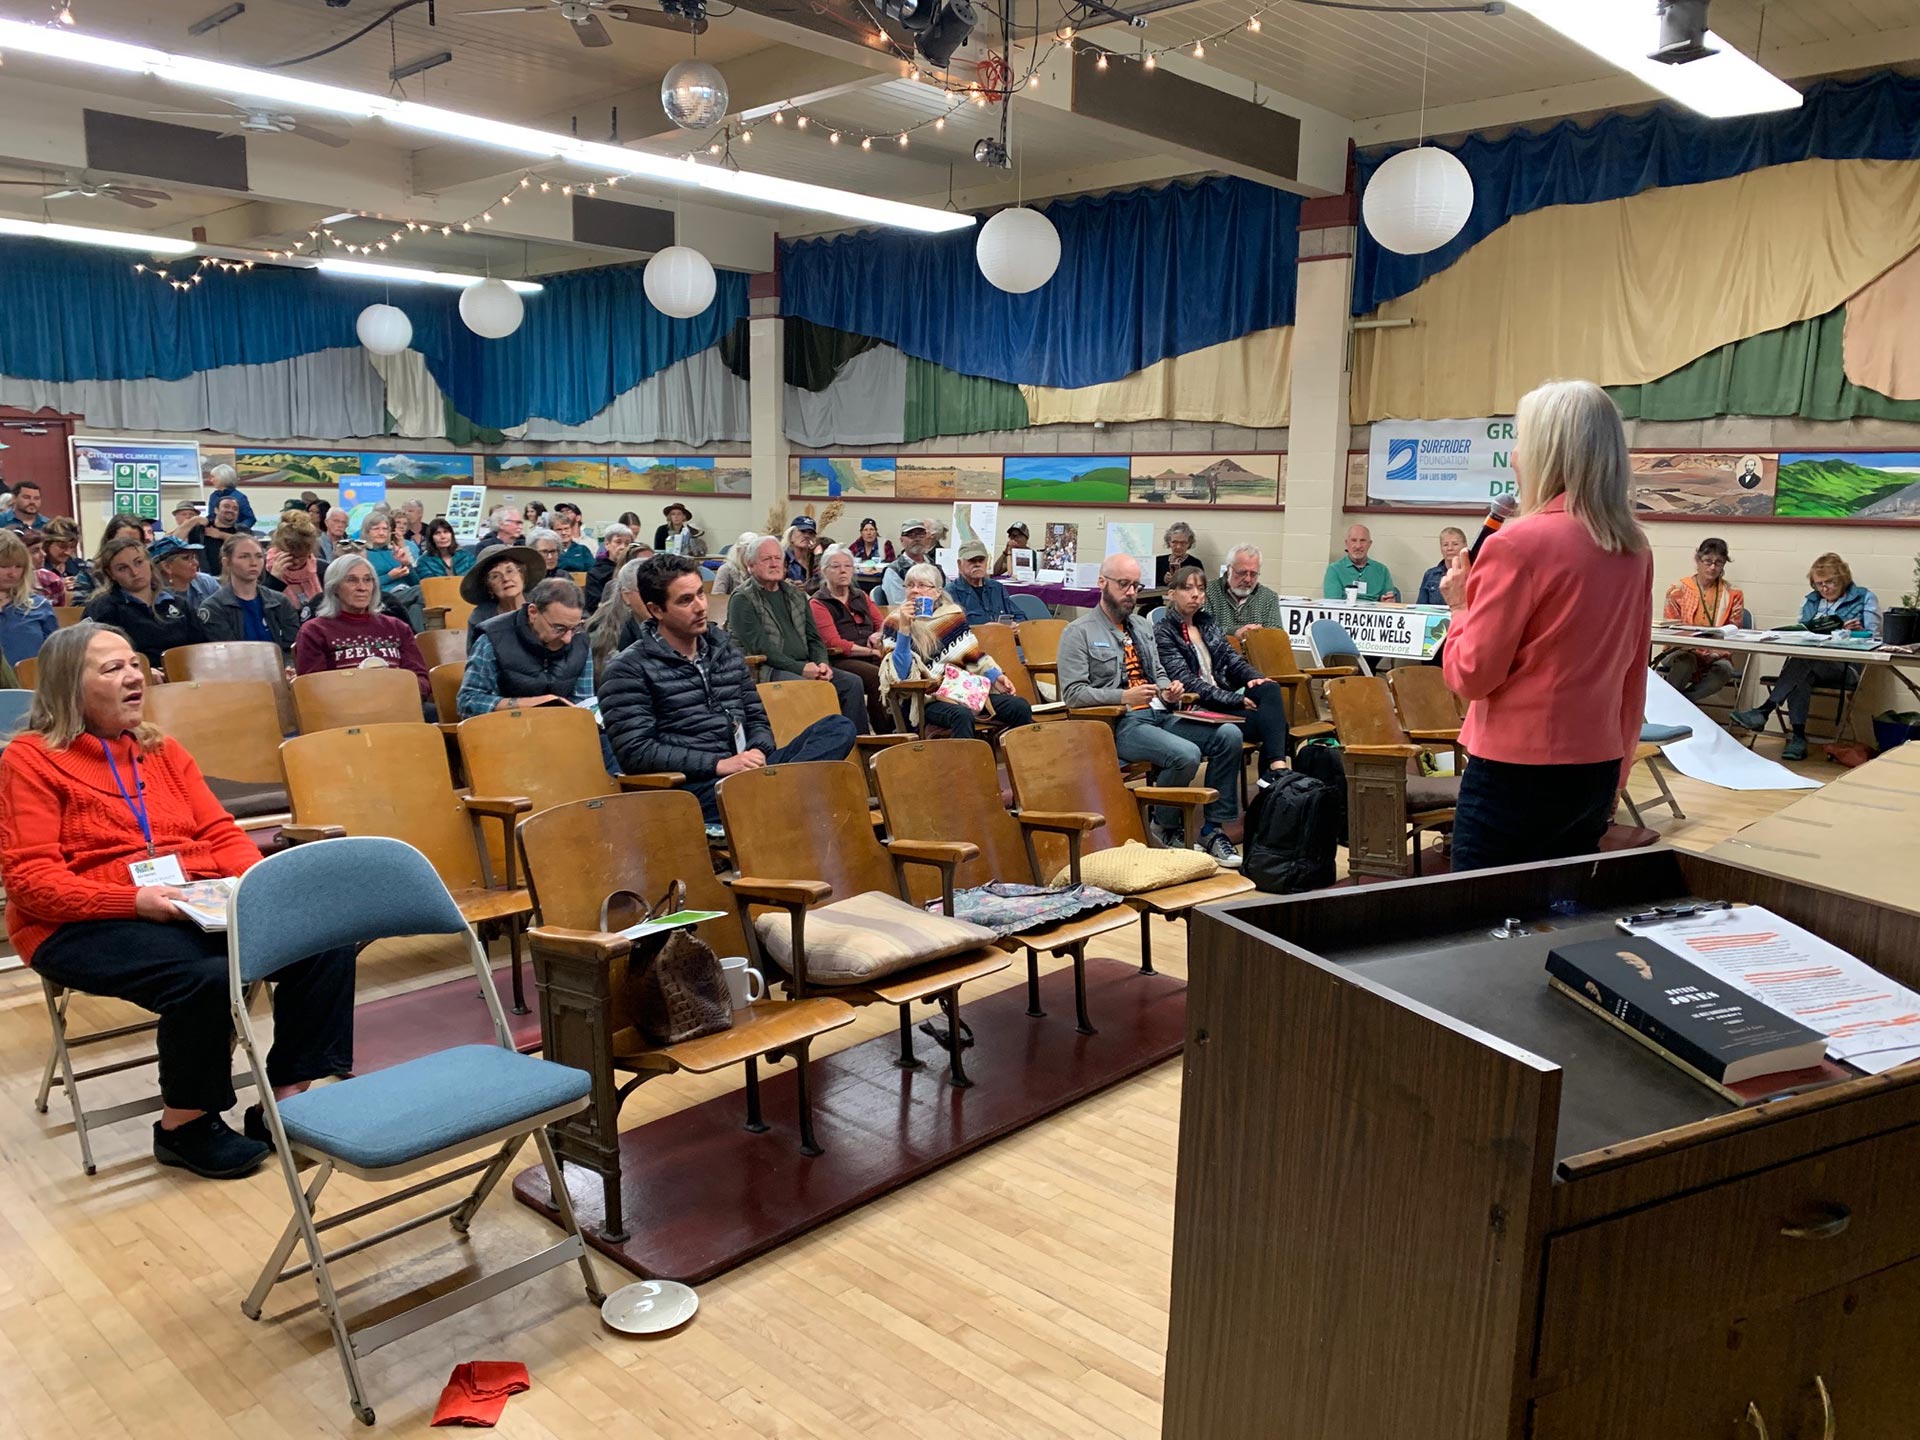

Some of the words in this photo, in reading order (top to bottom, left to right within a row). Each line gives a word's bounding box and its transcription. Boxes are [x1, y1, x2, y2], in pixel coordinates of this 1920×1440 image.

[1420, 439, 1472, 454] SURFRIDER
[87, 452, 124, 460] CITIZENS
[1419, 455, 1469, 466] FOUNDATION
[1441, 473, 1457, 481] OBISPO
[1339, 613, 1393, 629] FRACKING
[1397, 616, 1406, 629] &
[1361, 628, 1376, 642] OIL
[1380, 629, 1411, 644] WELLS
[335, 647, 375, 661] FEEL
[1357, 642, 1410, 654] SLOcounty.org
[1667, 990, 1720, 1005] JONES
